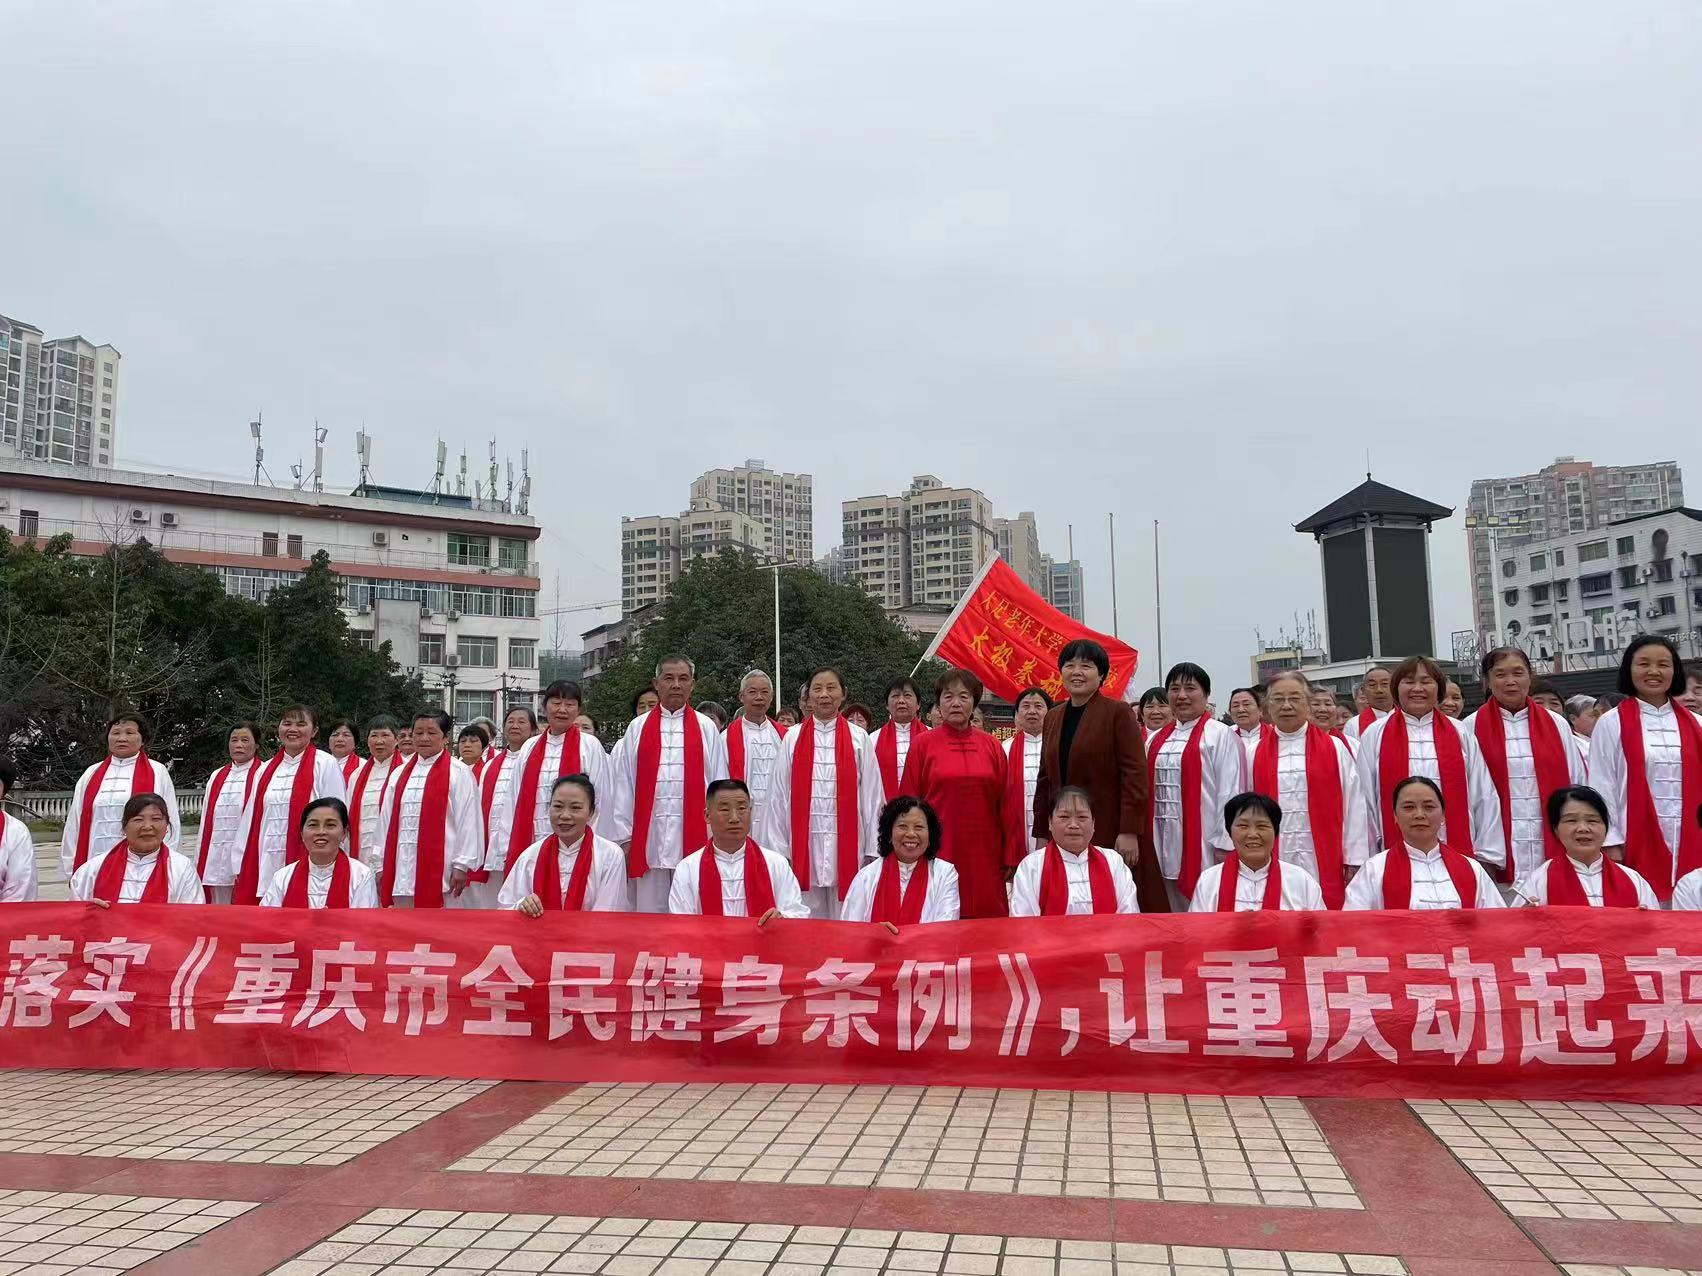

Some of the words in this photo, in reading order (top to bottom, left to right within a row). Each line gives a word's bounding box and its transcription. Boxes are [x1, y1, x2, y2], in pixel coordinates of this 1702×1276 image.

[979, 590, 1064, 653] 大足老年大学
